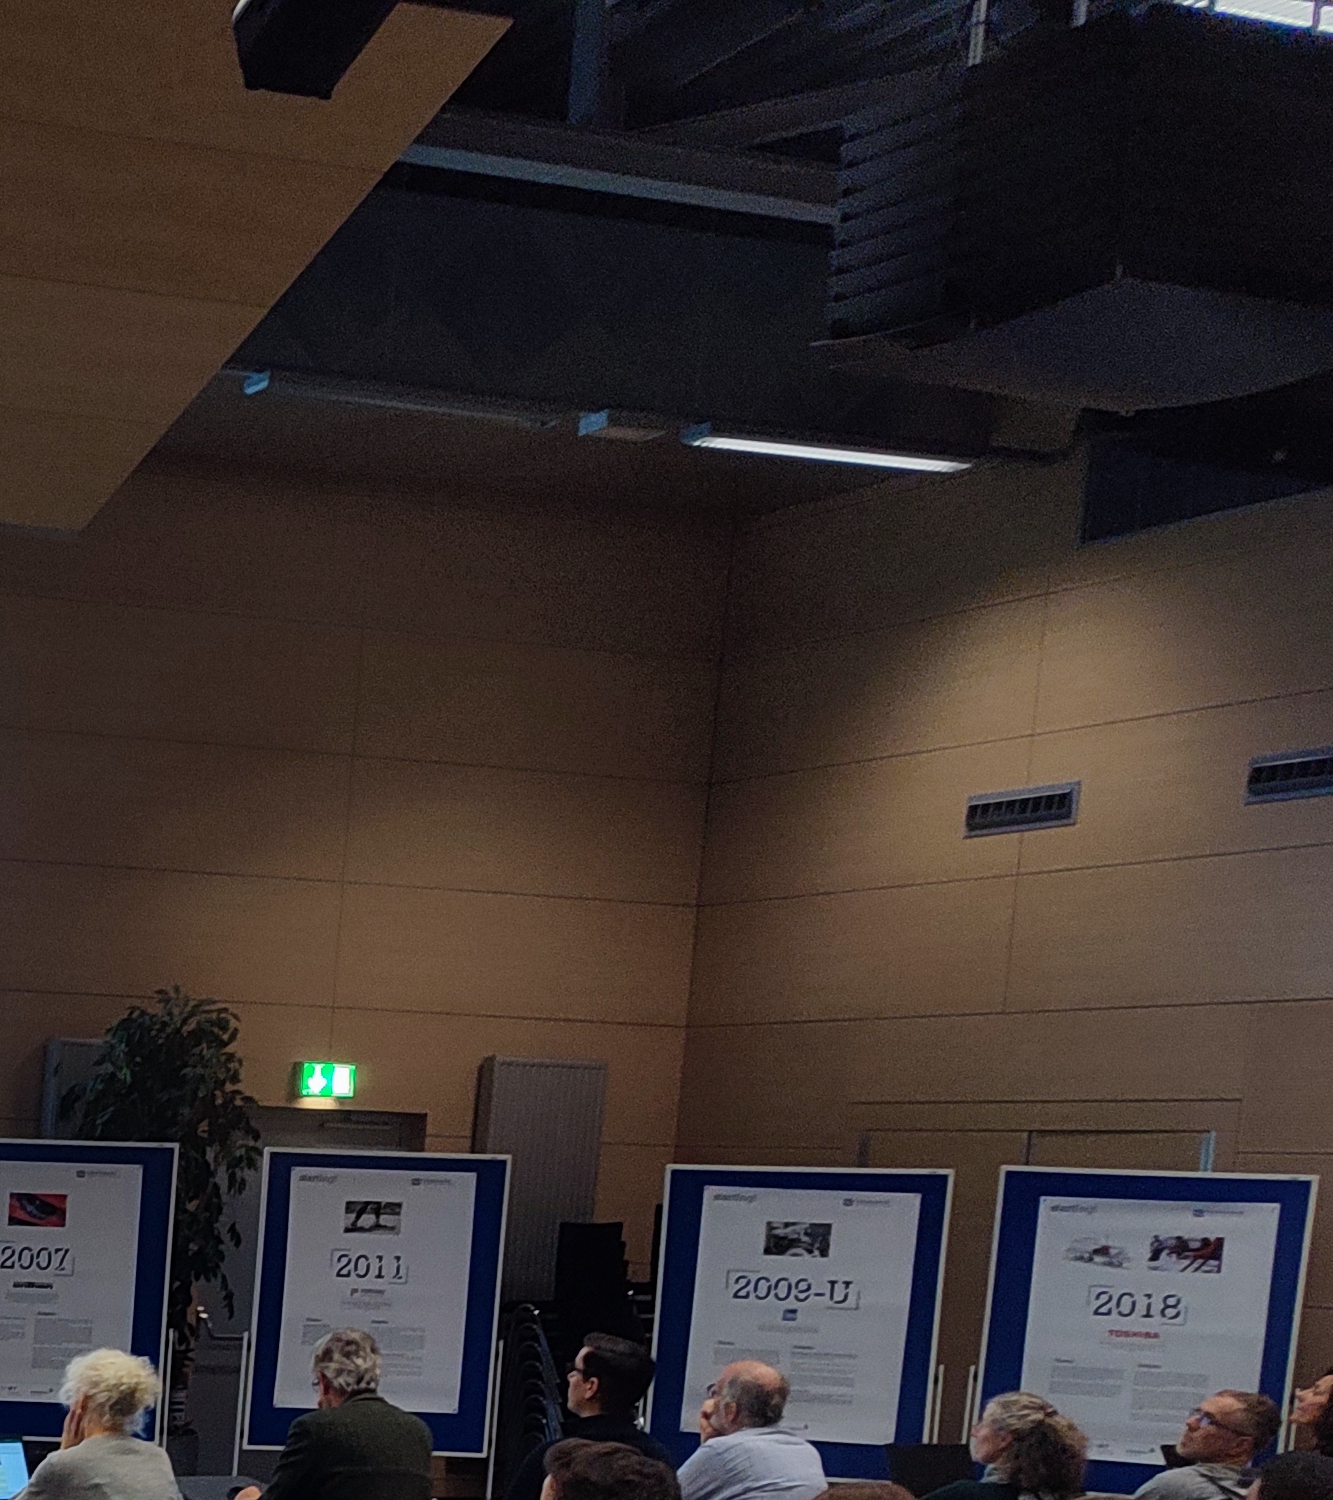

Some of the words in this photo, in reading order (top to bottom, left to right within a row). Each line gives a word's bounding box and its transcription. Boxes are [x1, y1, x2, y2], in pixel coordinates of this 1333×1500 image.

[0, 1245, 71, 1272] 2007
[335, 1253, 404, 1280] 2011
[732, 1274, 853, 1305] 2009-U
[1092, 1290, 1183, 1320] 2018
